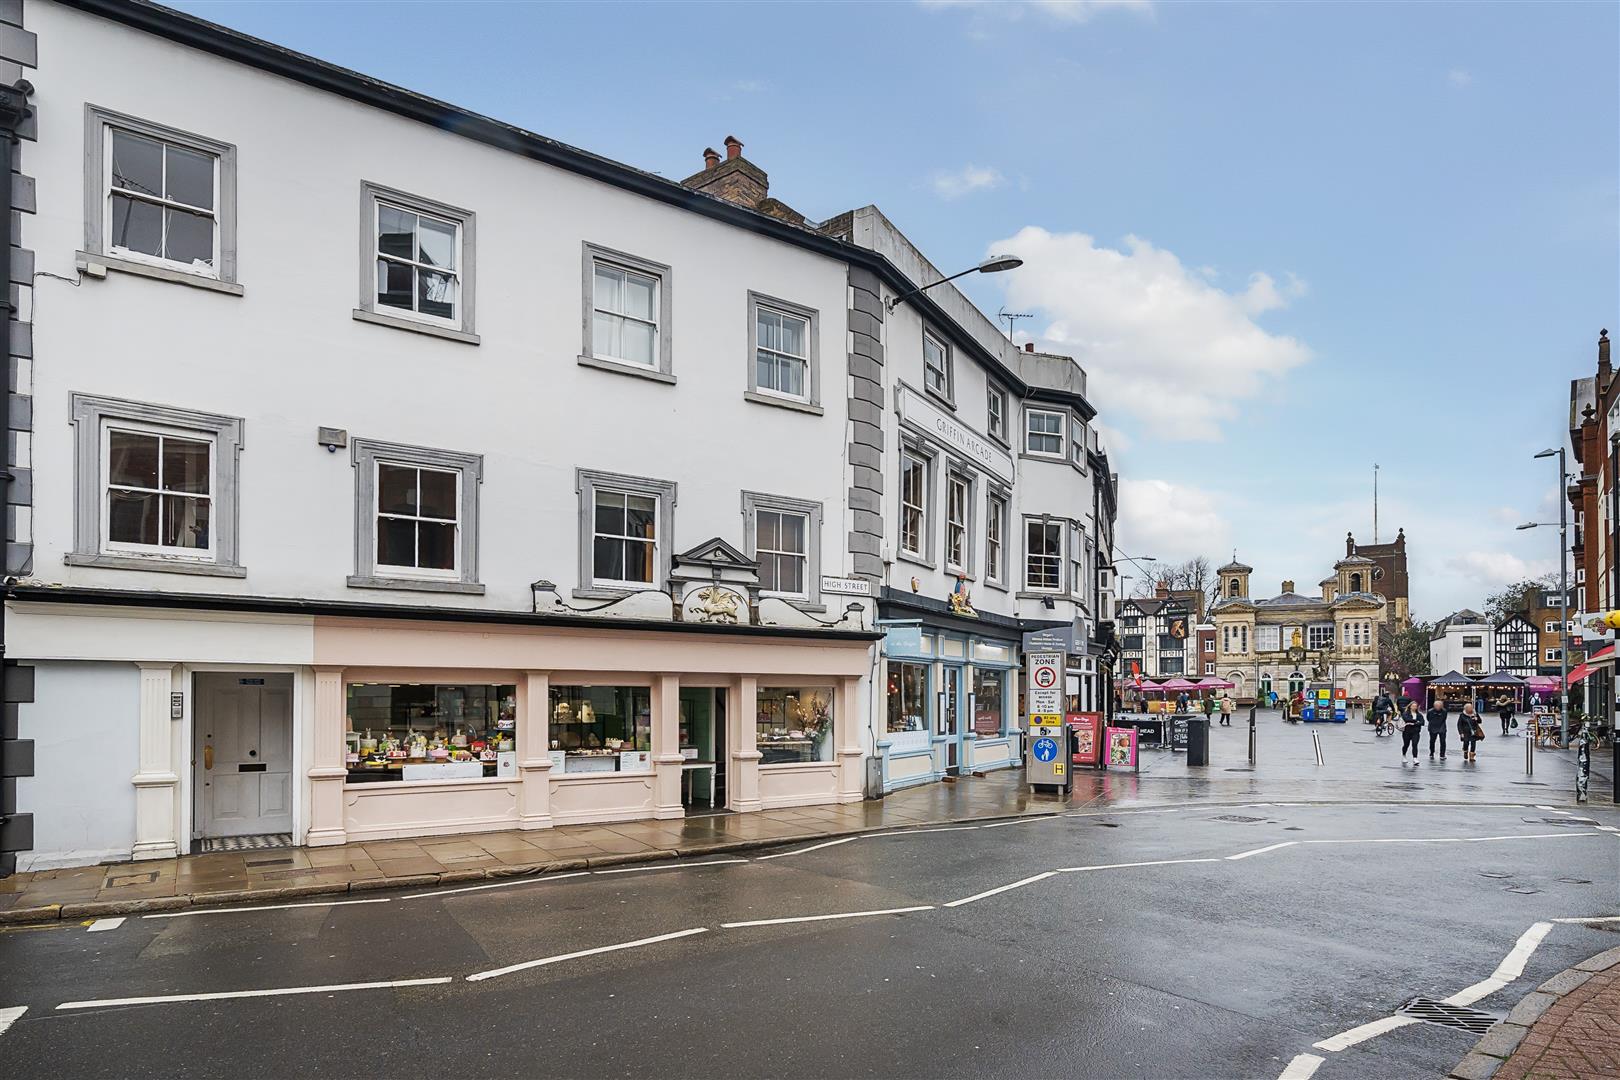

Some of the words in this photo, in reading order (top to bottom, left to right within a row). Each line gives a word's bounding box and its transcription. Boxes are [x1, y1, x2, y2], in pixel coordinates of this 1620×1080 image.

[936, 418, 965, 445] GRIFFIN
[966, 438, 992, 463] ARCADE
[824, 580, 842, 589] HIGH
[844, 582, 868, 591] STREET
[1055, 764, 1064, 774] H
